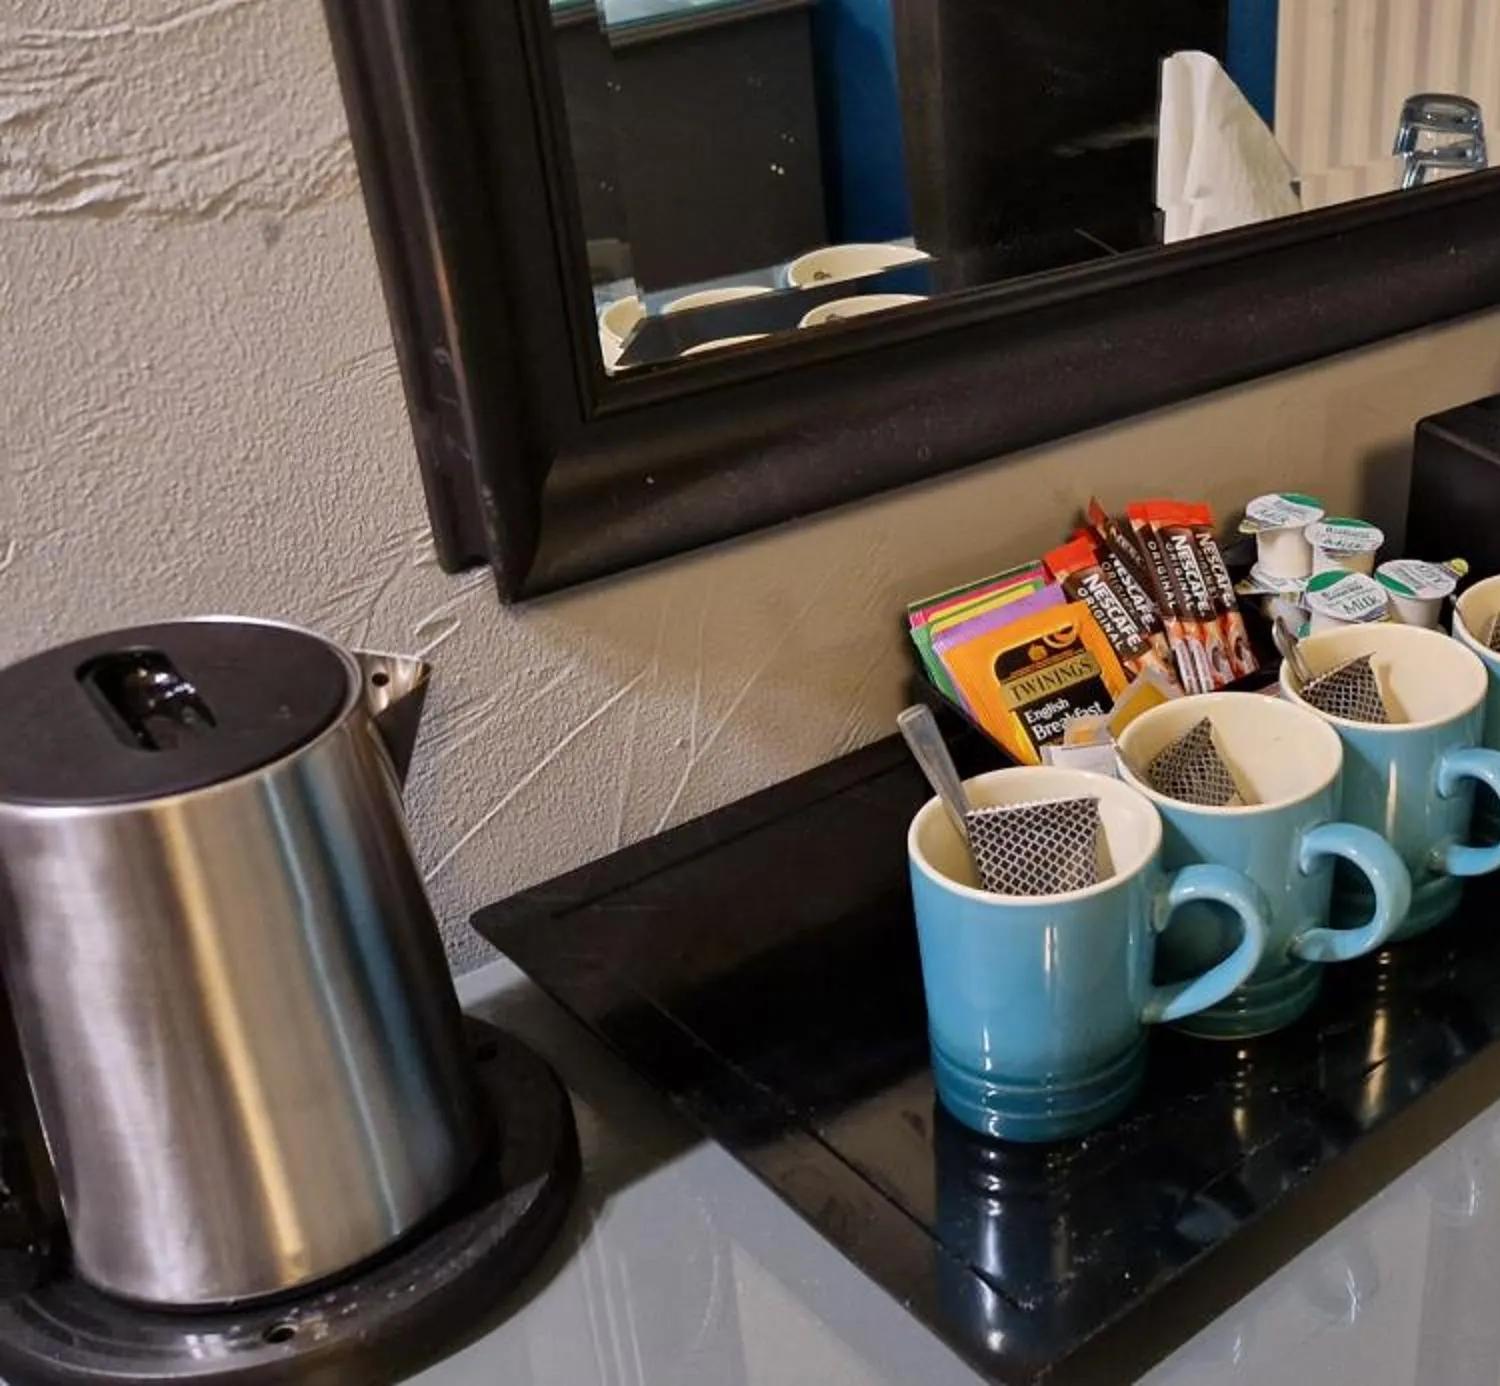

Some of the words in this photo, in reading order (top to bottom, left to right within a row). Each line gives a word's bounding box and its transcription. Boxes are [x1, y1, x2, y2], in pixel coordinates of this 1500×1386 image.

[1147, 540, 1177, 609] ORIGINAL
[1165, 541, 1196, 611] ORIGINAL
[1077, 587, 1122, 651] ORIGINAL
[1343, 595, 1377, 615] Milk
[1011, 661, 1093, 700] TWININGS
[1024, 697, 1070, 723] English
